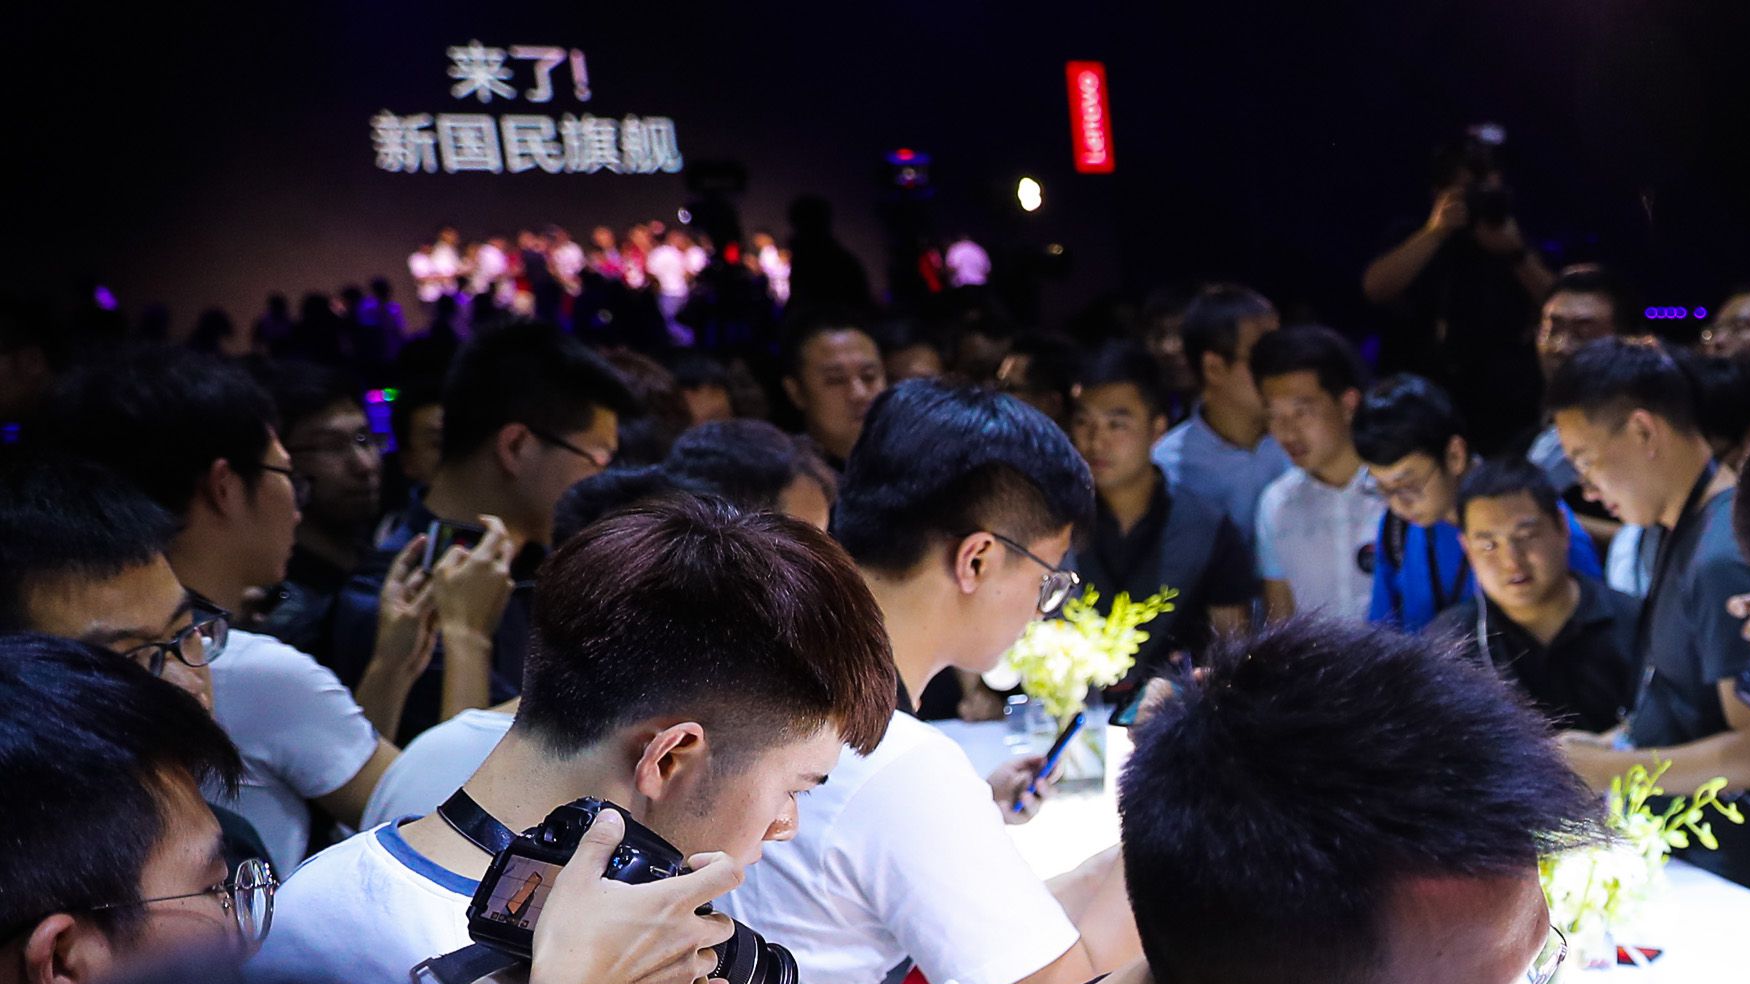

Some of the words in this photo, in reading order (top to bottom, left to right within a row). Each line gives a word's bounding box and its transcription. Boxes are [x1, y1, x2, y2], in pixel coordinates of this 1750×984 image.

[369, 108, 684, 174] 新国民旗舰
